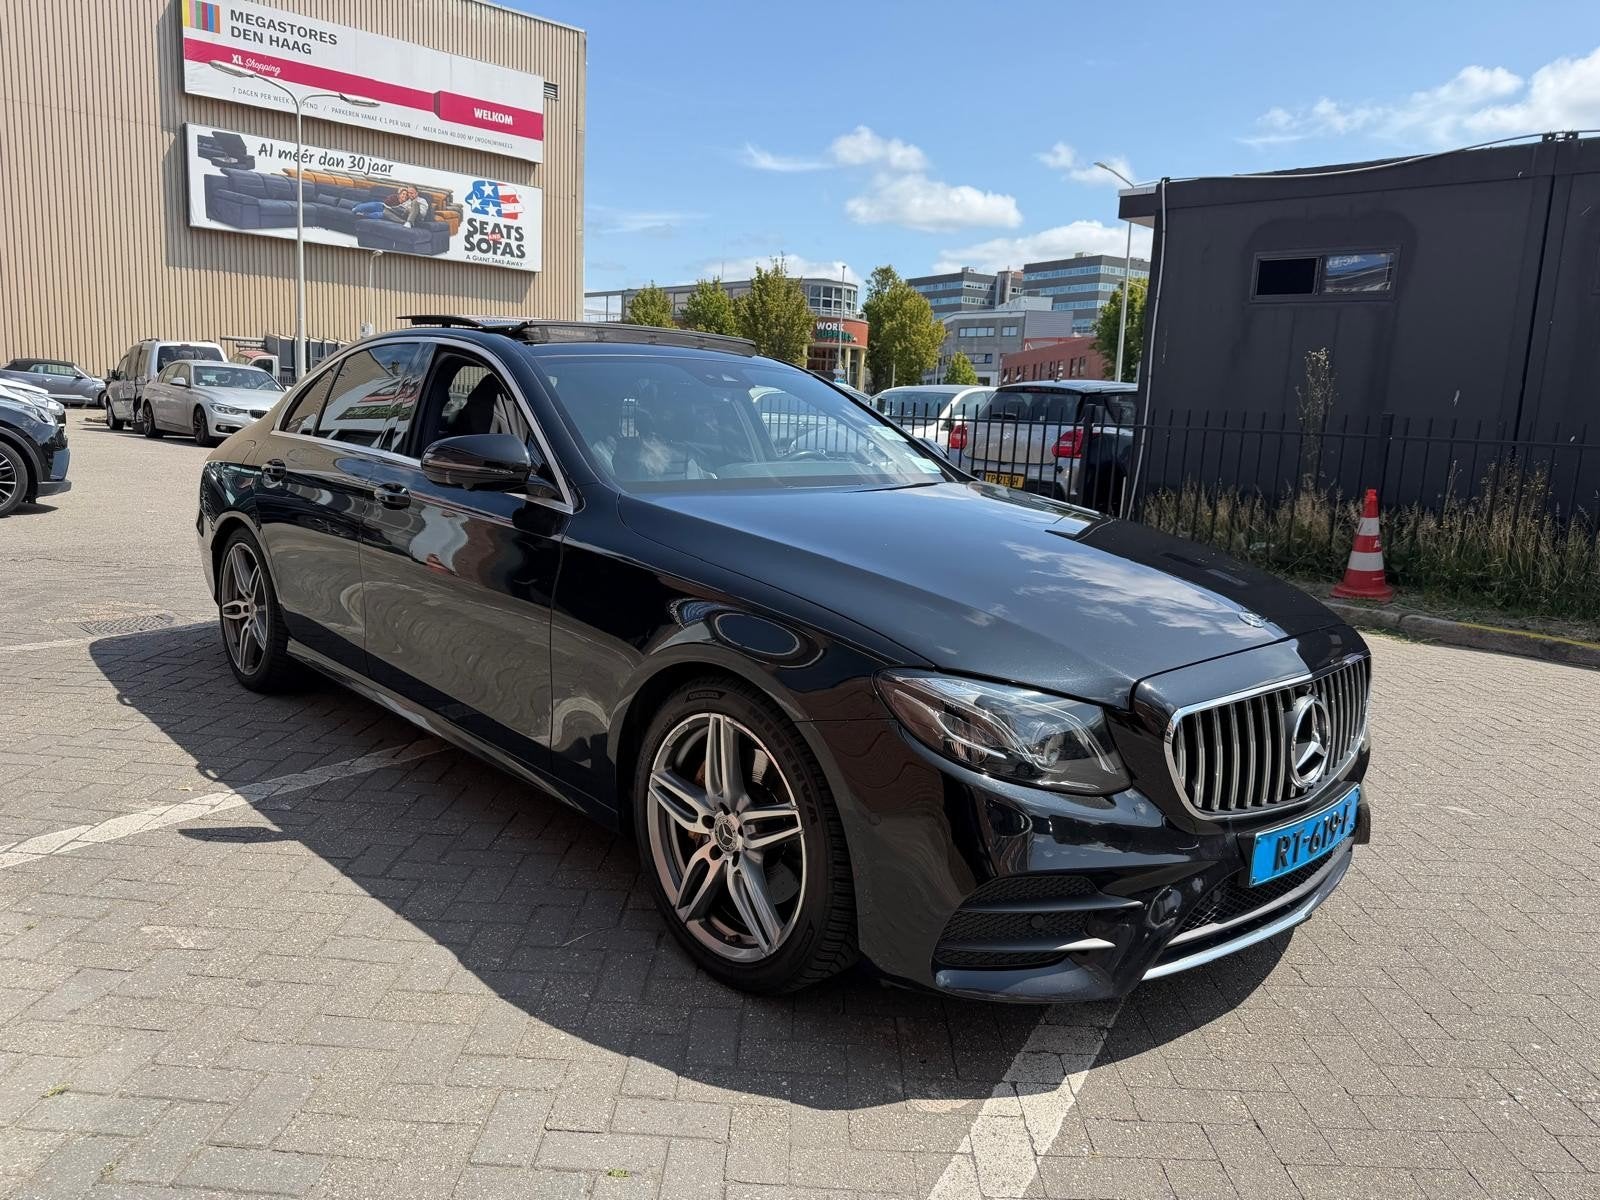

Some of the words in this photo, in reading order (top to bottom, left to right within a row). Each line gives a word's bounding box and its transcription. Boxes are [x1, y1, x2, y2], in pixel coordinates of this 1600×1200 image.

[230, 9, 338, 45] MEGASTORES
[230, 25, 264, 44] DEN
[269, 34, 312, 55] HAAG
[231, 53, 244, 65] XL
[245, 58, 281, 77] Shopping
[238, 88, 259, 98] DAGEN
[260, 92, 271, 101] PER
[272, 95, 290, 105] WEEK
[331, 107, 360, 118] PARKEREN
[360, 113, 378, 122] VANAF
[388, 118, 399, 126] PER
[422, 126, 437, 134] MEER
[438, 128, 449, 136] DAN
[473, 107, 514, 126] WELKOM
[258, 143, 274, 158] Al
[318, 151, 345, 169] dan
[348, 155, 365, 170] 30
[363, 158, 394, 176] jaar
[467, 217, 525, 243] SEATS
[464, 233, 526, 259] SOFAS
[472, 255, 490, 263] GIANT
[816, 321, 845, 331] WORK
[816, 329, 854, 343] SUPPIES
[987, 474, 1020, 486] TP213H
